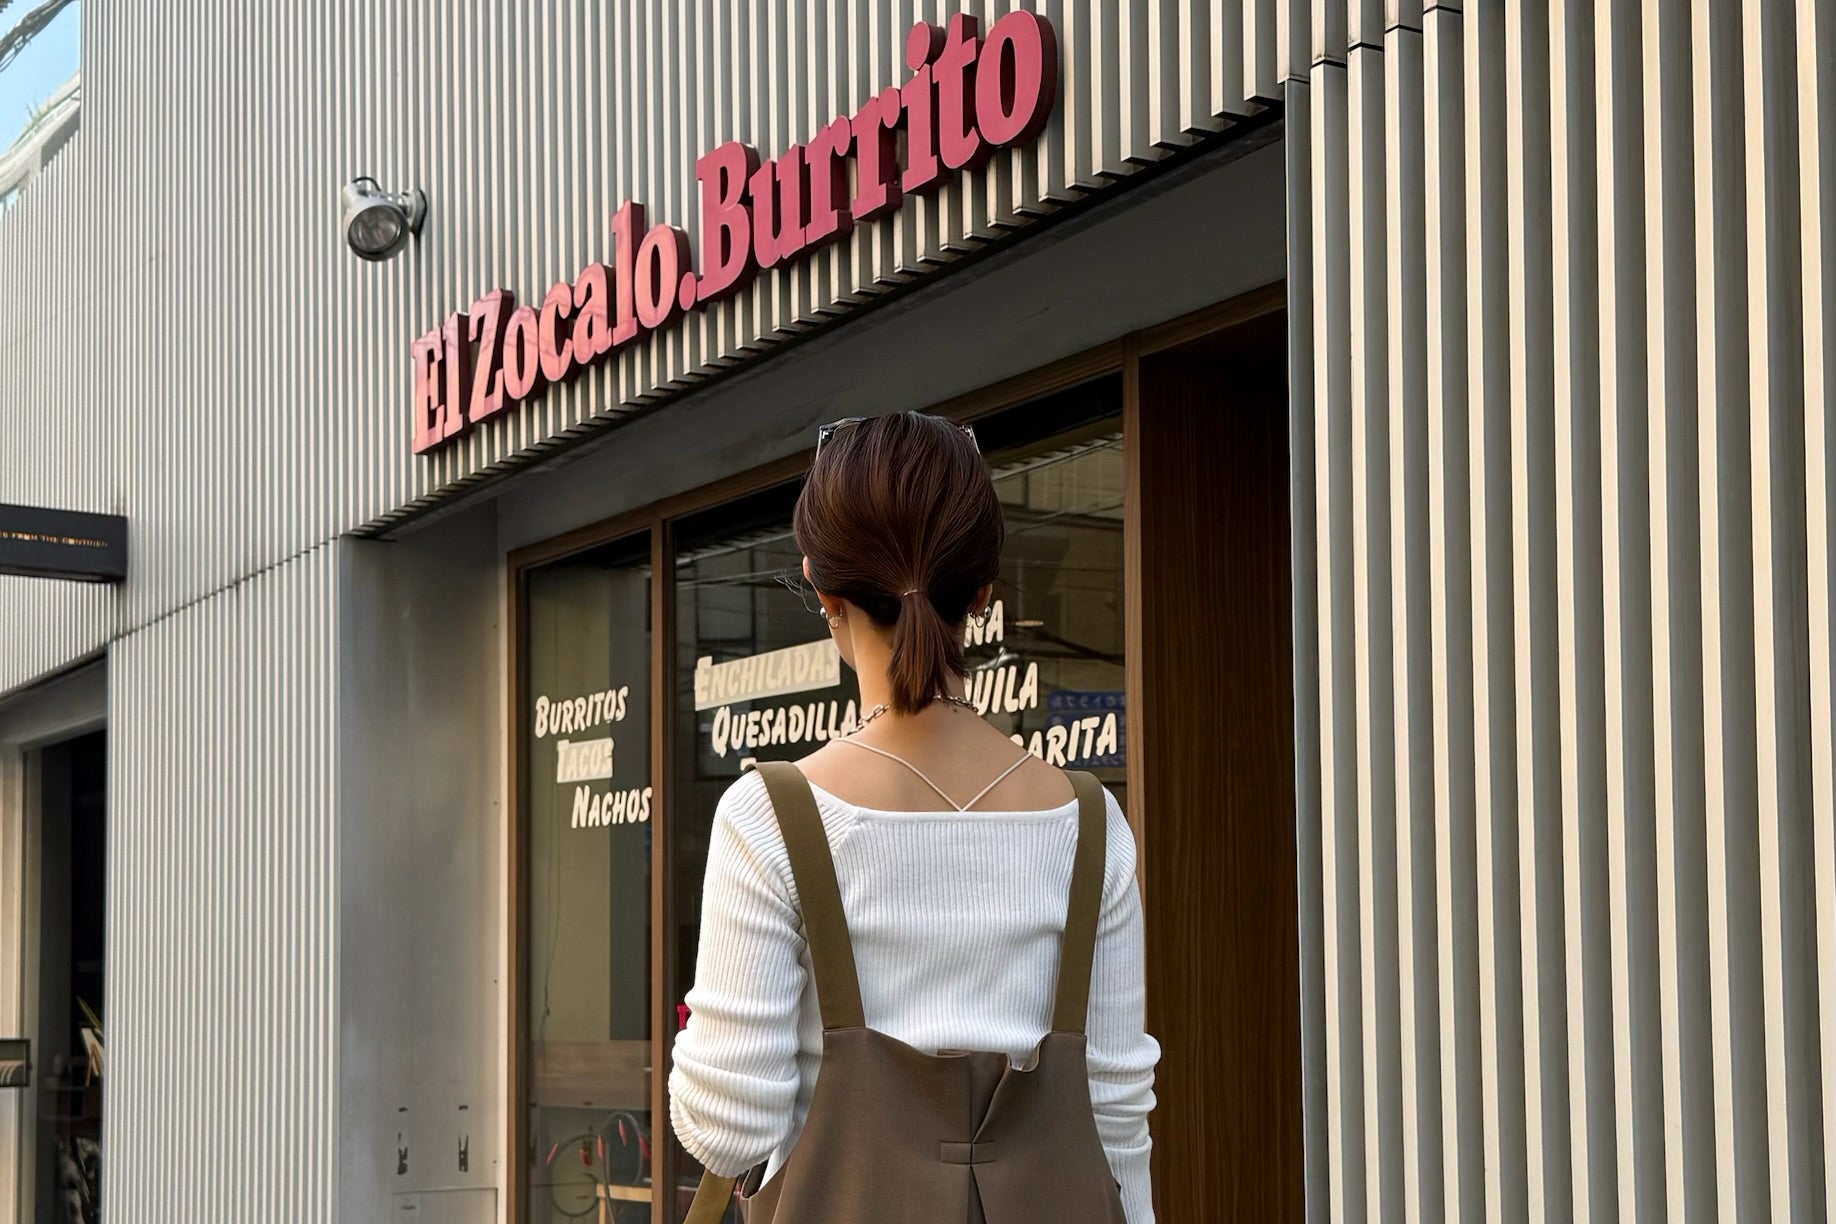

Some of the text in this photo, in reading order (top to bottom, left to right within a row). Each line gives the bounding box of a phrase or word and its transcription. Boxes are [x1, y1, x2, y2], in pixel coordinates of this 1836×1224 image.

[411, 311, 464, 454] El
[695, 641, 840, 703] ENCHILADAS
[964, 662, 1038, 716] UILA
[535, 686, 629, 738] BURRITOS
[557, 738, 614, 783] TACOS
[571, 785, 653, 829] NACHOS
